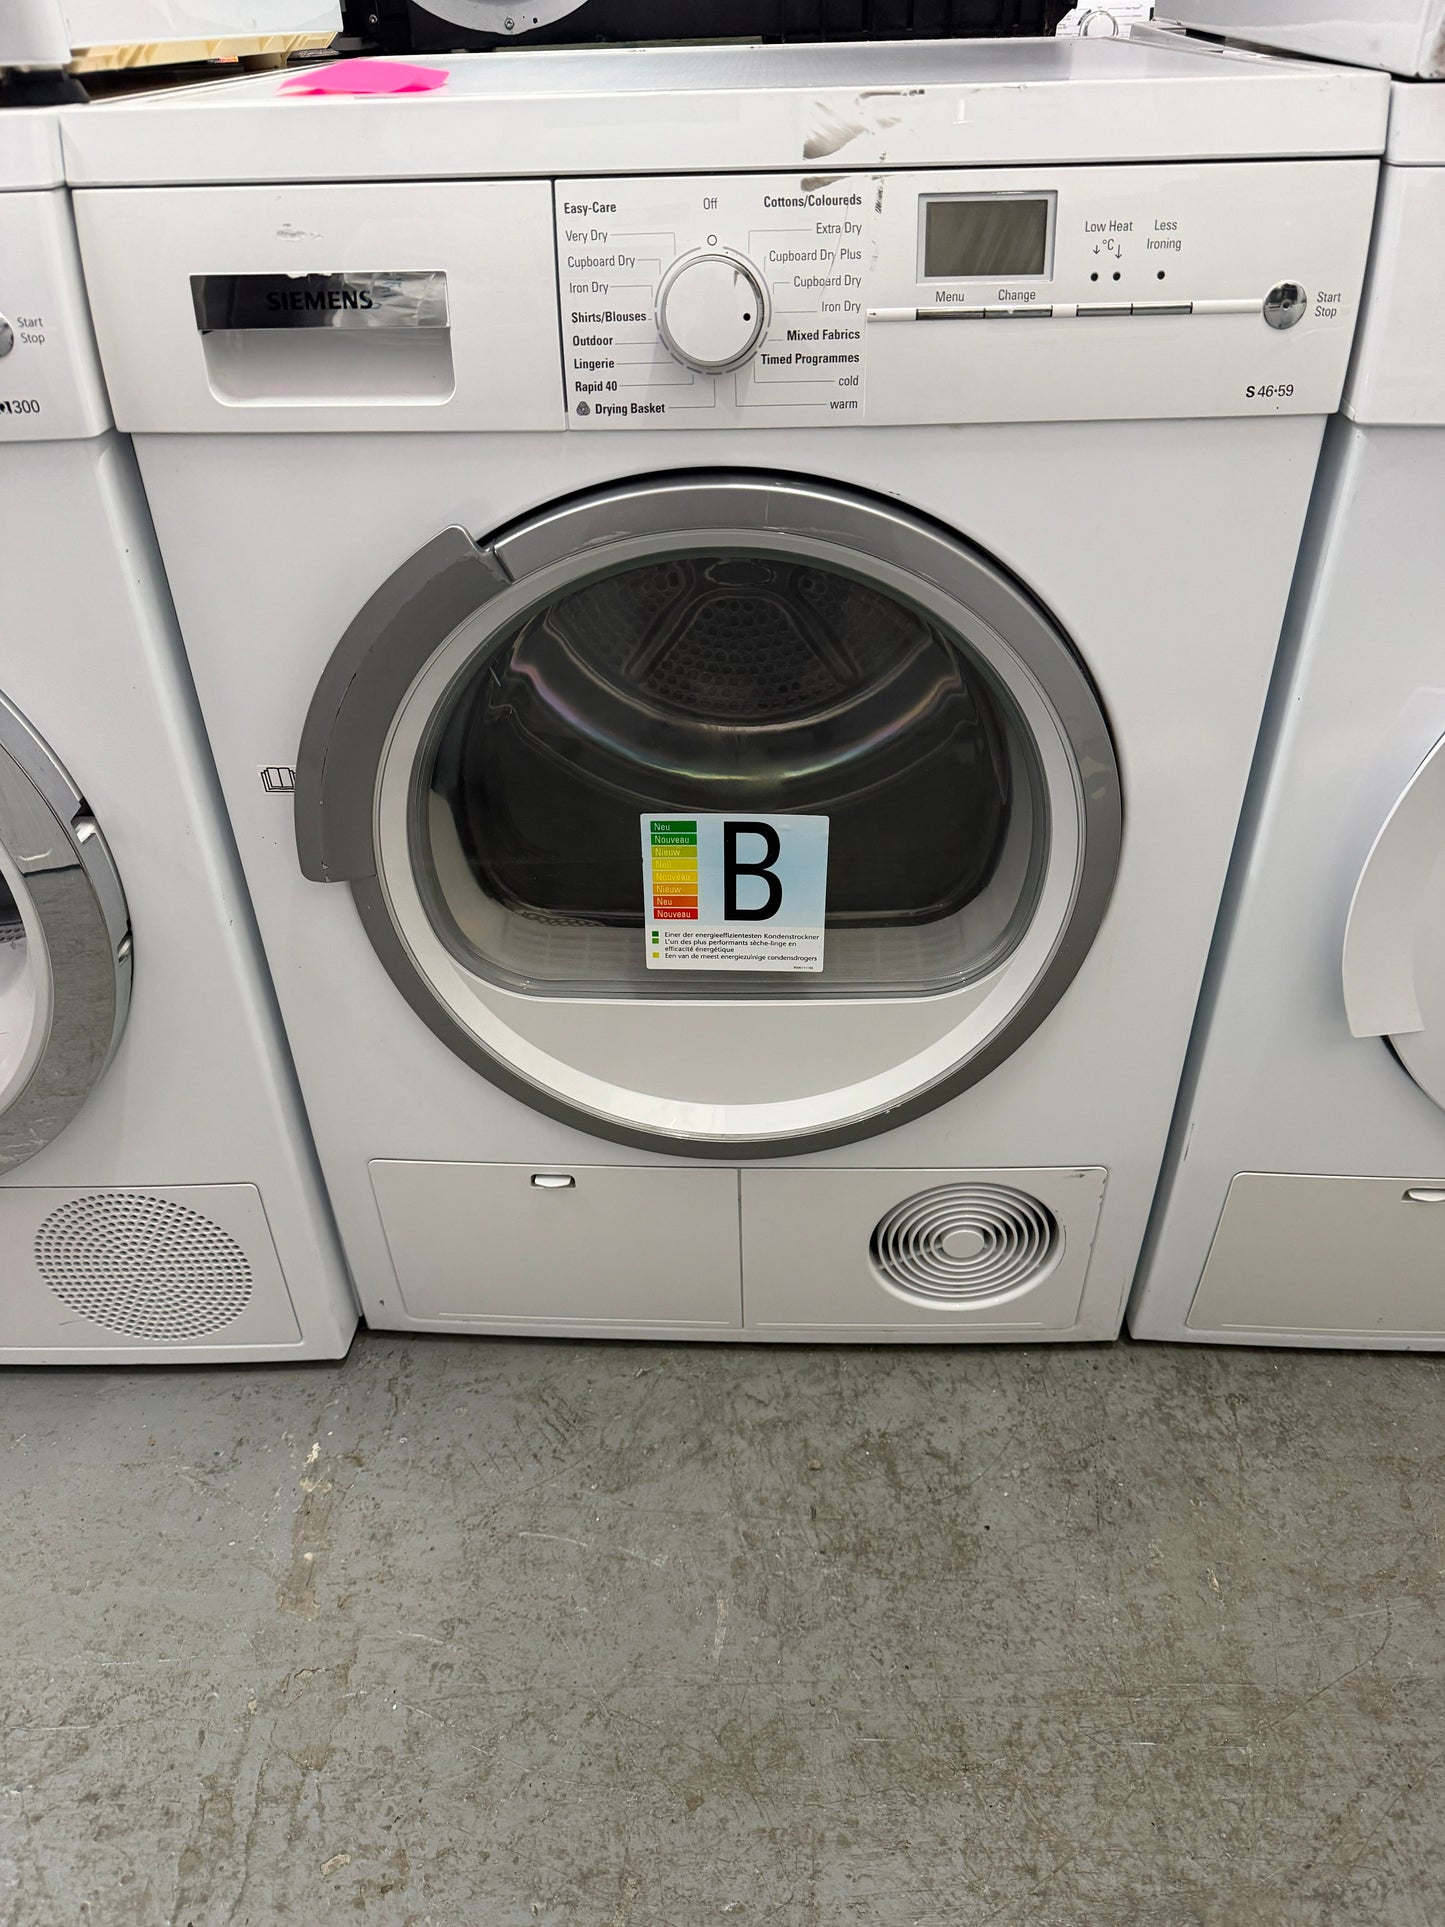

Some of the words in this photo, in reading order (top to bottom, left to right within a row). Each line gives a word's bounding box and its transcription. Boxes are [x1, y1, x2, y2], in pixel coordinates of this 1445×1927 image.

[703, 197, 719, 210] Off
[763, 193, 862, 208] Cottons/Coloureds
[564, 201, 617, 216] Easy-Care
[816, 222, 841, 234] Extra
[844, 221, 862, 236] Dry
[1085, 220, 1107, 232] Low
[1109, 220, 1133, 232] Heat
[1154, 219, 1178, 231] Less
[565, 230, 588, 244] Very
[590, 229, 608, 243] Dry
[1146, 237, 1182, 252] Ironing
[567, 256, 616, 270] Cupboard
[618, 254, 636, 268] Dry
[769, 249, 818, 264] Cupboard
[820, 248, 836, 263] Dry
[840, 248, 862, 260] Plus
[569, 282, 589, 294] Iron
[591, 281, 609, 295] Dry
[793, 275, 842, 290] Cupboard
[844, 274, 862, 289] Dry
[267, 290, 374, 311] SIEMENS
[935, 290, 965, 303] Menu
[998, 288, 1036, 303] Change
[1317, 290, 1342, 303] Start
[821, 301, 841, 313] Iron
[844, 300, 862, 314] Dry
[1314, 305, 1338, 319] Stop
[17, 316, 44, 329] Start
[571, 310, 647, 324] Shirts/Blouses
[20, 332, 46, 346] Stop
[572, 335, 614, 347] Outdoor
[787, 329, 820, 342] Mixed
[822, 328, 861, 341] Fabrics
[574, 358, 615, 371] Lingerie
[761, 353, 793, 366] Timed
[795, 352, 861, 367] Programmes
[575, 381, 603, 395] Rapid
[605, 380, 618, 392] 40
[838, 374, 859, 387] cold
[1245, 384, 1256, 399] S
[595, 402, 628, 417] Drying
[630, 402, 666, 414] Basket
[829, 399, 859, 410] warm
[653, 822, 671, 832] Neu
[653, 835, 690, 845] Nouveau
[654, 847, 682, 857] Nieuw
[655, 872, 691, 882] Nouveau
[723, 821, 783, 922] B
[656, 885, 682, 894] Nieuw
[656, 897, 673, 907] Neu
[657, 909, 692, 919] Nouveau
[695, 932, 762, 940] energieeffizientesten
[695, 946, 735, 954] énergétique
[720, 954, 766, 962] energiezuinige
[767, 955, 818, 963] condensdrogers
